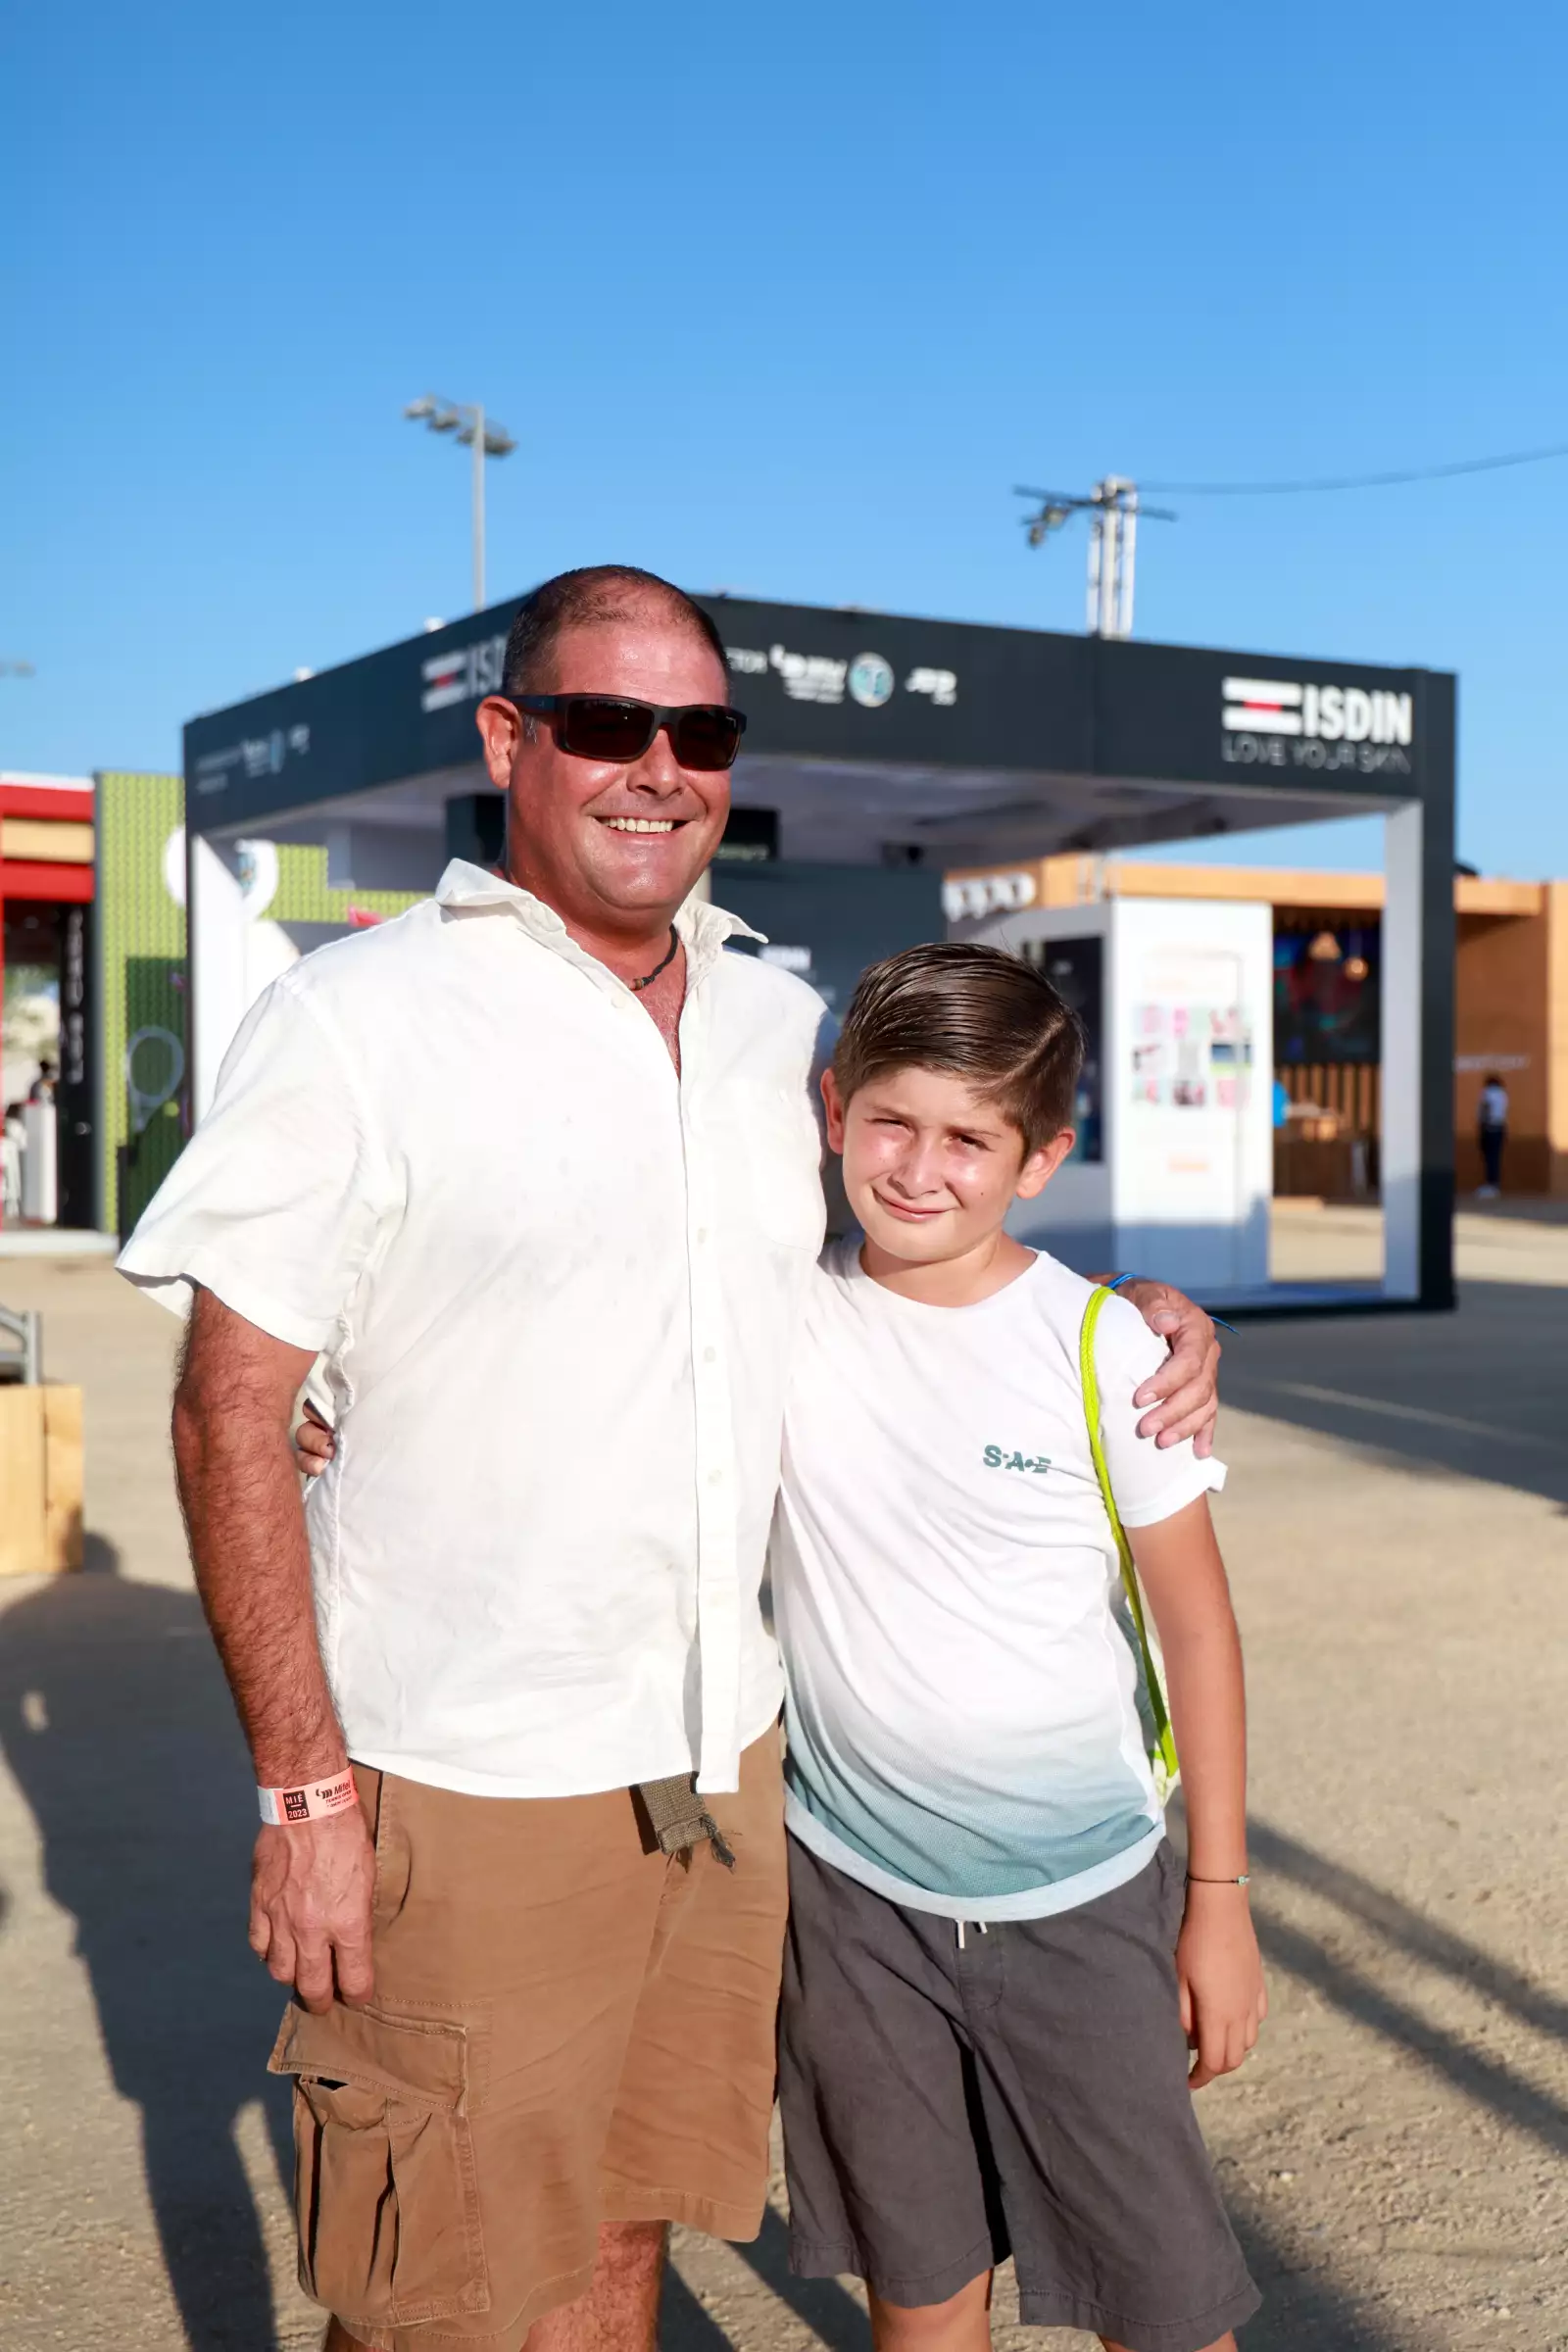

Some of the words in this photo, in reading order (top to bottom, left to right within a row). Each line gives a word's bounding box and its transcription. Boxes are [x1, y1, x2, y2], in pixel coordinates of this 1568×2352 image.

[1301, 684, 1412, 746] ISDIN
[1221, 733, 1286, 766] LOVE
[334, 1780, 351, 1794] Mifel
[288, 1807, 309, 1820] 2023
